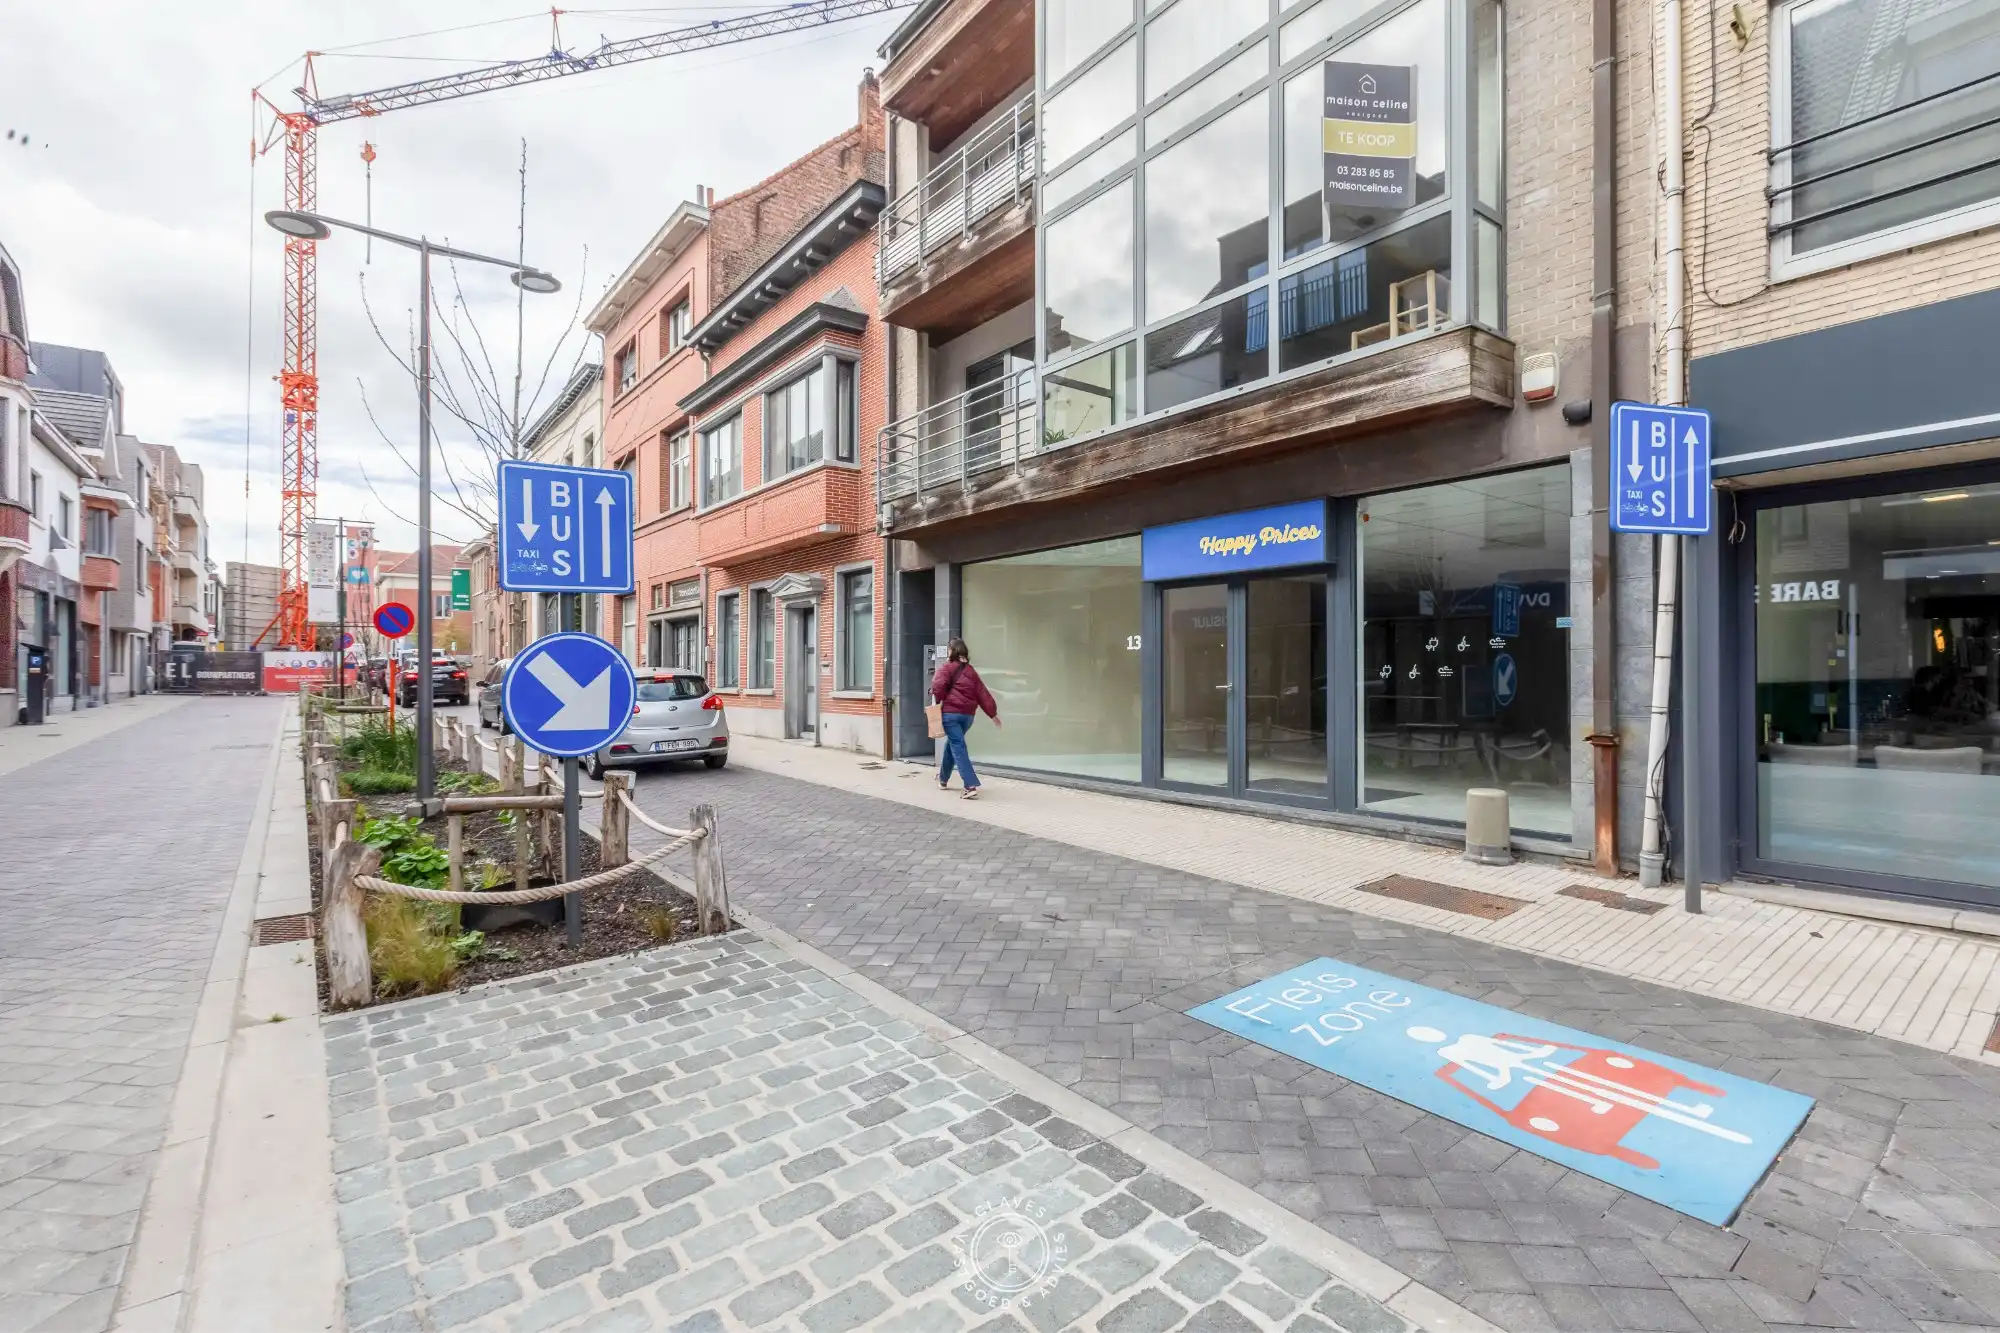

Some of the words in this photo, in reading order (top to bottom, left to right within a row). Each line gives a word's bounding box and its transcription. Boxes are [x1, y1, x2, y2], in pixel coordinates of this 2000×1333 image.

[1326, 96, 1368, 107] maison
[1372, 100, 1408, 109] celine
[1337, 131, 1354, 144] TE
[1357, 134, 1395, 147] KOOP
[1337, 165, 1349, 175] 03
[1350, 167, 1367, 177] 283
[1369, 168, 1381, 178] 85
[1383, 169, 1395, 179] 85
[1329, 180, 1403, 193] maisonceline.be
[1651, 421, 1666, 517] BUS
[1626, 490, 1643, 499] TAXI
[550, 480, 572, 576] BUS
[1200, 535, 1257, 556] Happy
[1259, 523, 1321, 546] Prices
[517, 549, 540, 559] TAXI
[1127, 635, 1141, 650] 13
[1224, 972, 1359, 1025] Fiets
[1290, 990, 1411, 1046] zone
